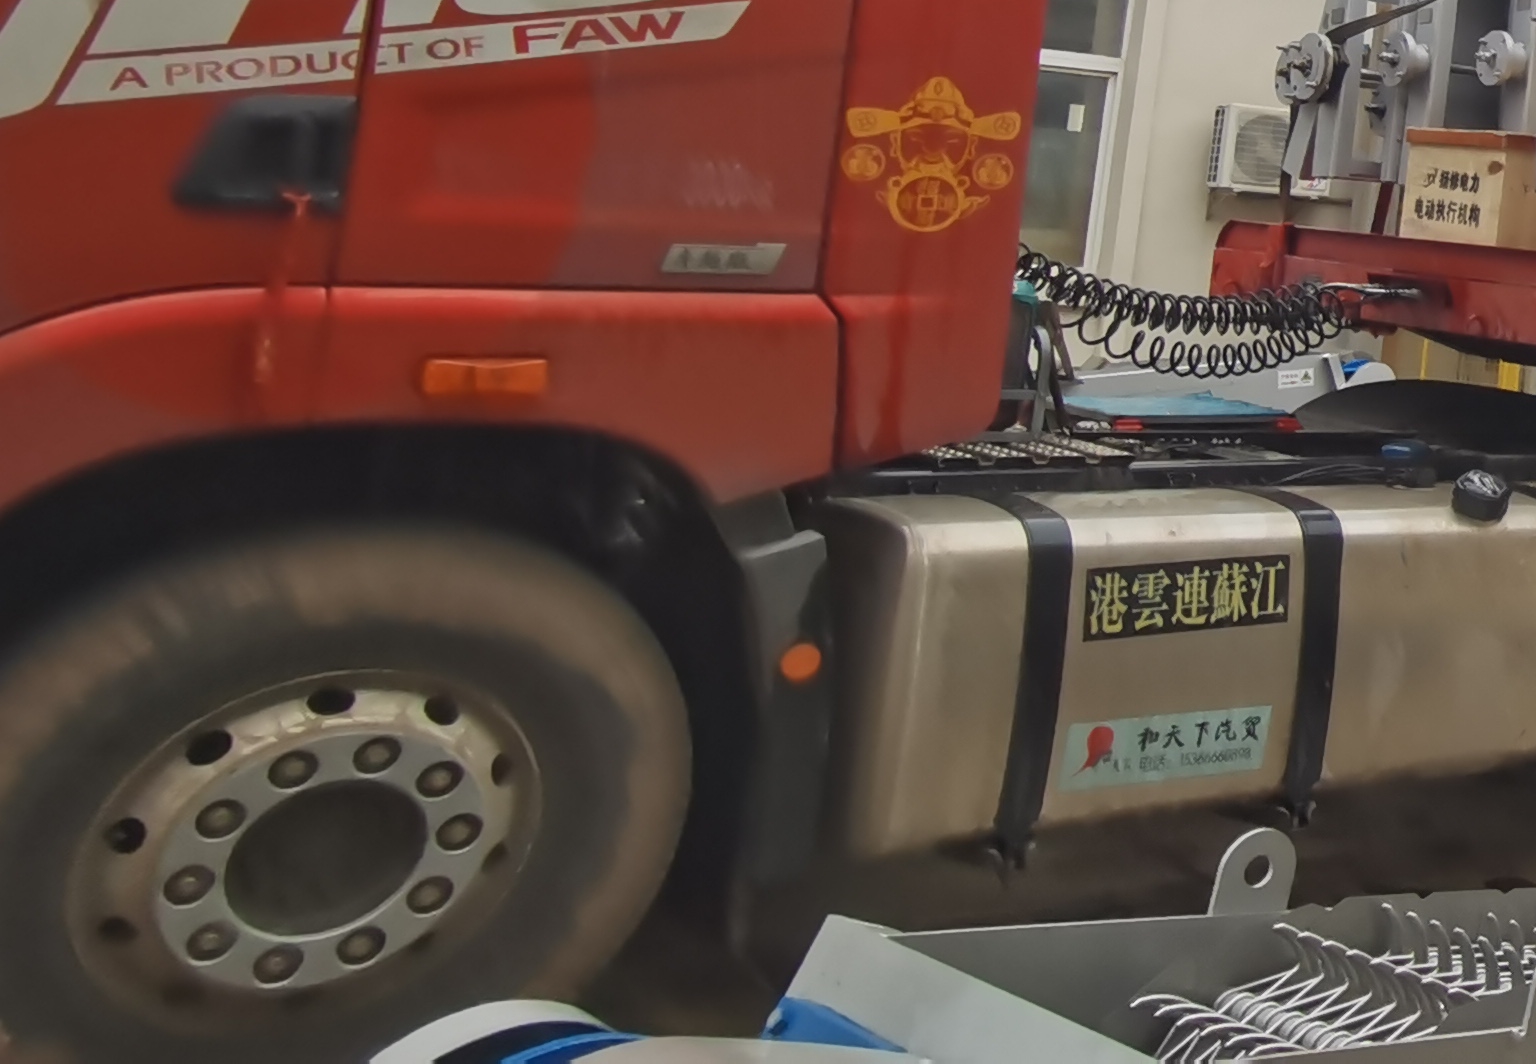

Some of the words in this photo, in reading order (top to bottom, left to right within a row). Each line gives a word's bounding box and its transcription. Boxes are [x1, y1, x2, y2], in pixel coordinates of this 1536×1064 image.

[109, 66, 148, 91] A
[164, 42, 413, 87] PRODUCT
[426, 37, 484, 62] OF
[512, 10, 686, 55] FAW
[1414, 195, 1481, 229] 电动执行机构
